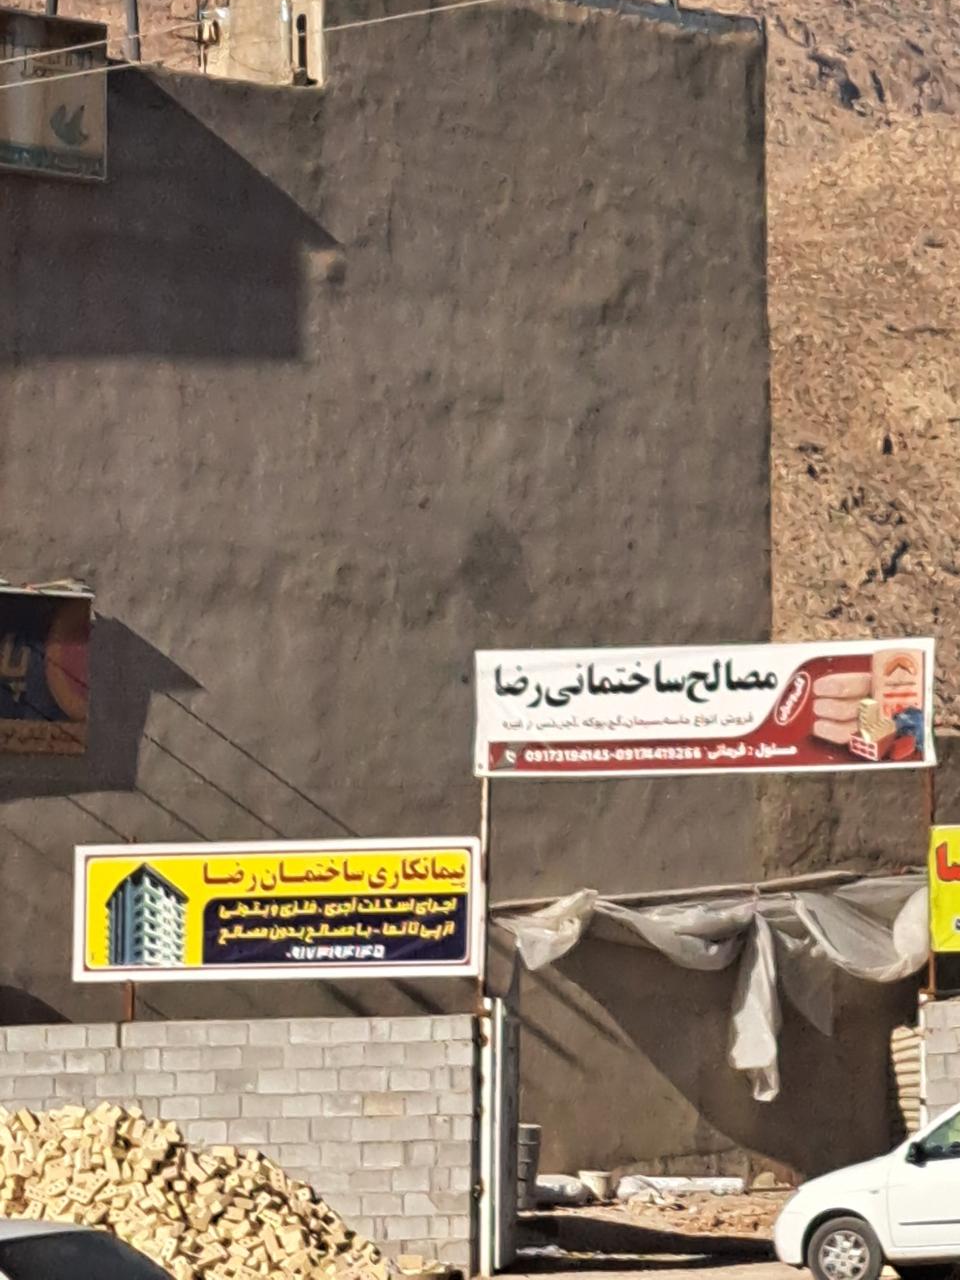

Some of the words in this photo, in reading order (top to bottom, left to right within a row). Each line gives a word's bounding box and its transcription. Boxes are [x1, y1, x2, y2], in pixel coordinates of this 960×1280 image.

[495, 663, 543, 708] رضا
[545, 659, 685, 708] ساختمانی
[686, 658, 778, 703] مصالح
[203, 862, 256, 892] رضا
[260, 859, 364, 891] ساختمان
[367, 857, 466, 889] پیمانکاری
